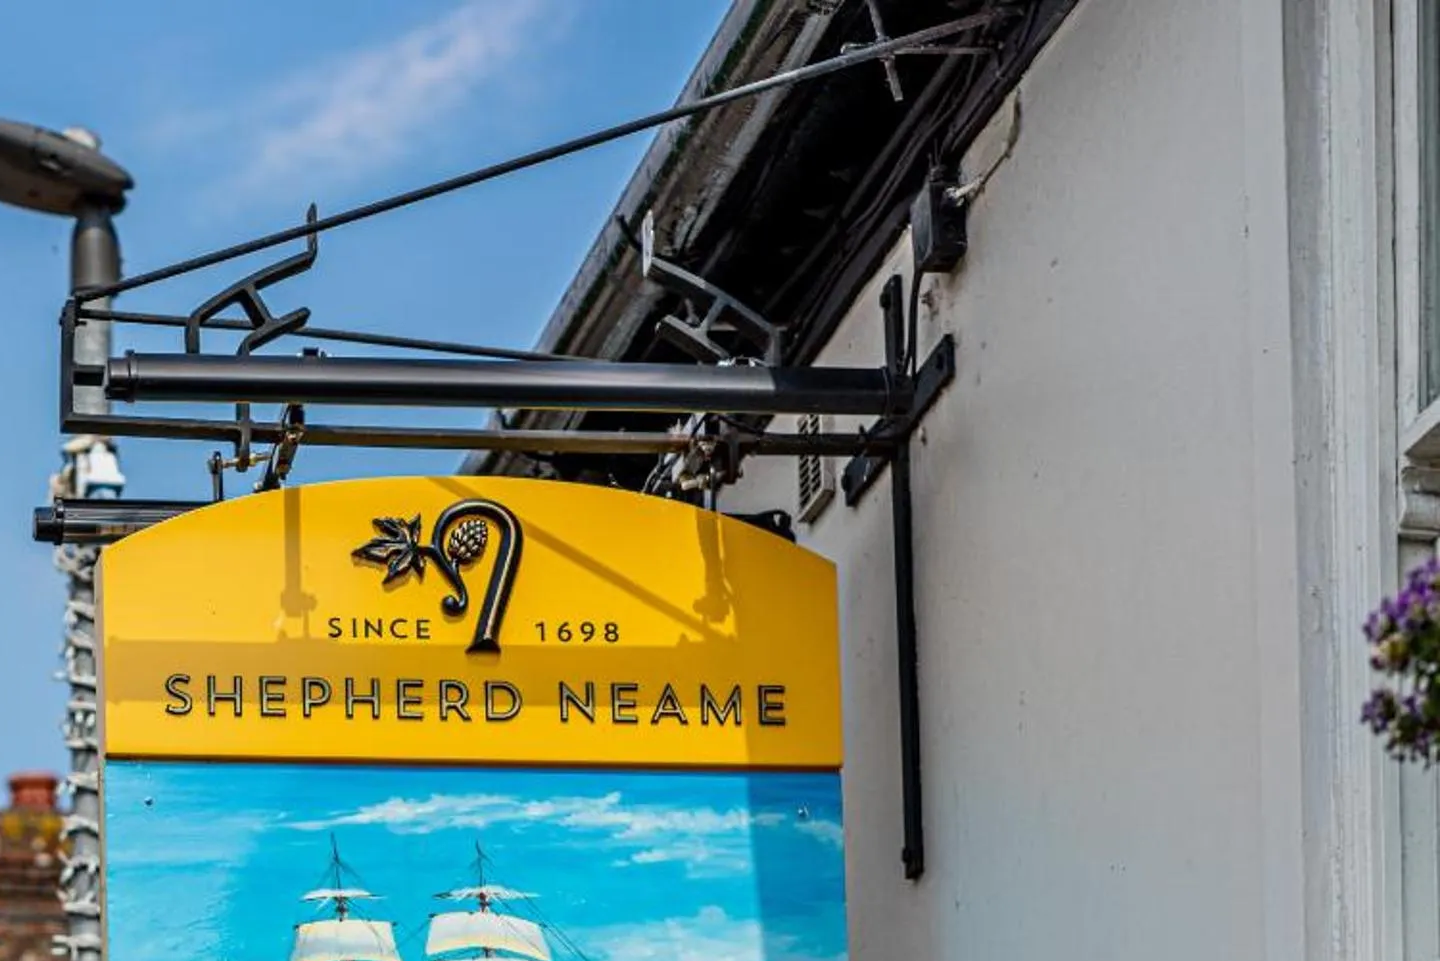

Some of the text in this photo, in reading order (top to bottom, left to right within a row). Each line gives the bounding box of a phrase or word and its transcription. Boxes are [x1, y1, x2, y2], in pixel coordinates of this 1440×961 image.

[328, 617, 621, 643] SINCE 1698
[164, 673, 789, 727] SHEPHERD NEAME
